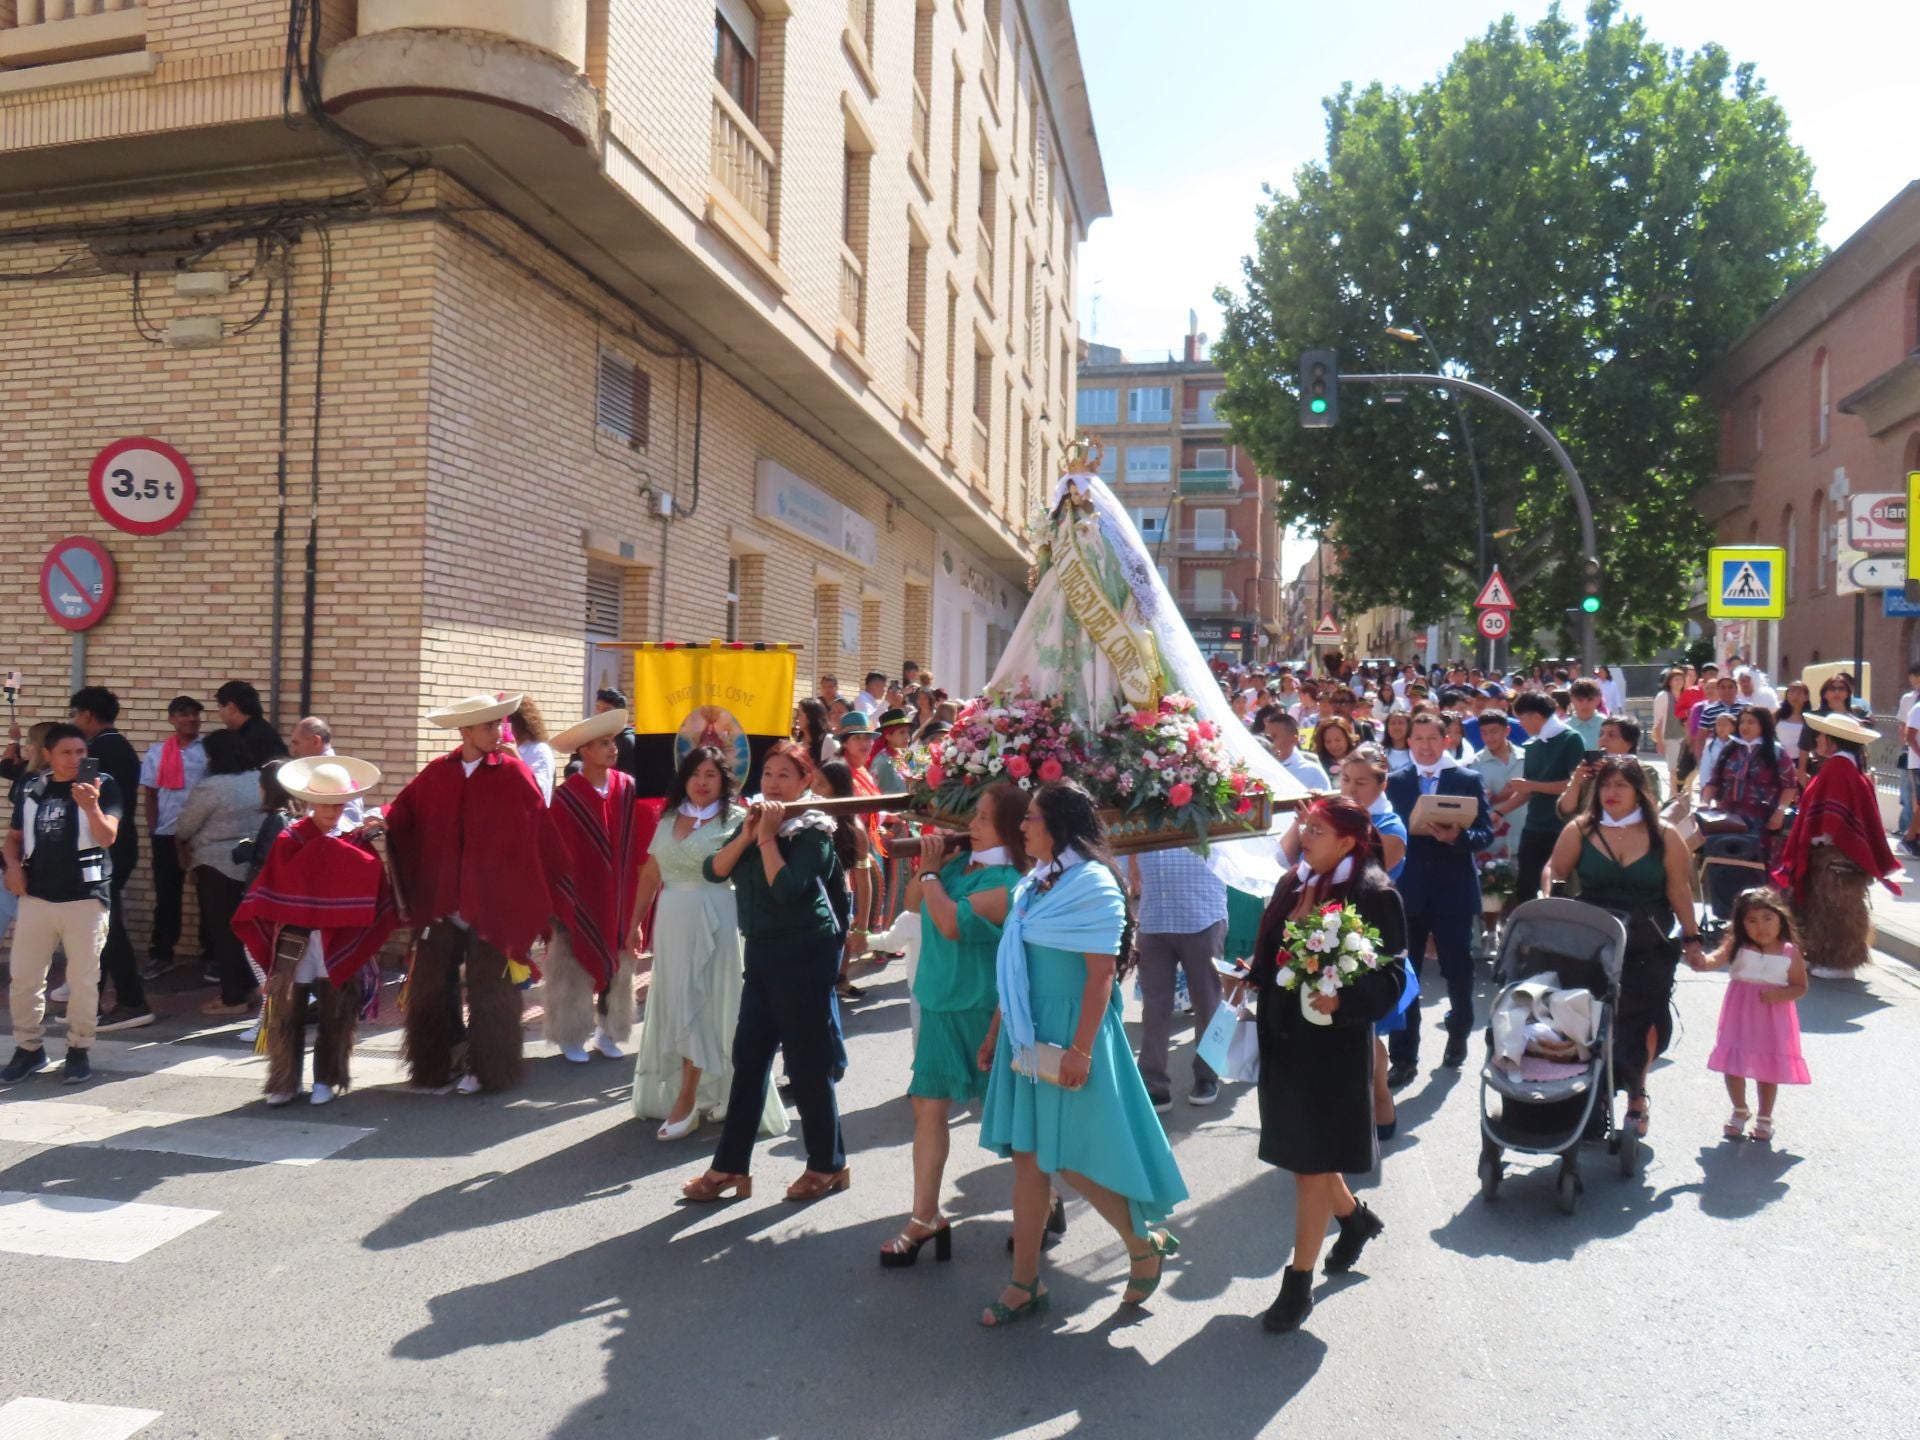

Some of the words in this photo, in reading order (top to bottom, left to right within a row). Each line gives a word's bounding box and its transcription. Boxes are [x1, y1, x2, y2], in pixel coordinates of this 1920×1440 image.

[1060, 559, 1102, 615] VIRGEN
[1085, 607, 1116, 642] DEL
[1107, 635, 1141, 681] CISNE
[1127, 675, 1148, 695] 2025
[1486, 619, 1503, 629] 30
[726, 686, 756, 707] CISNE
